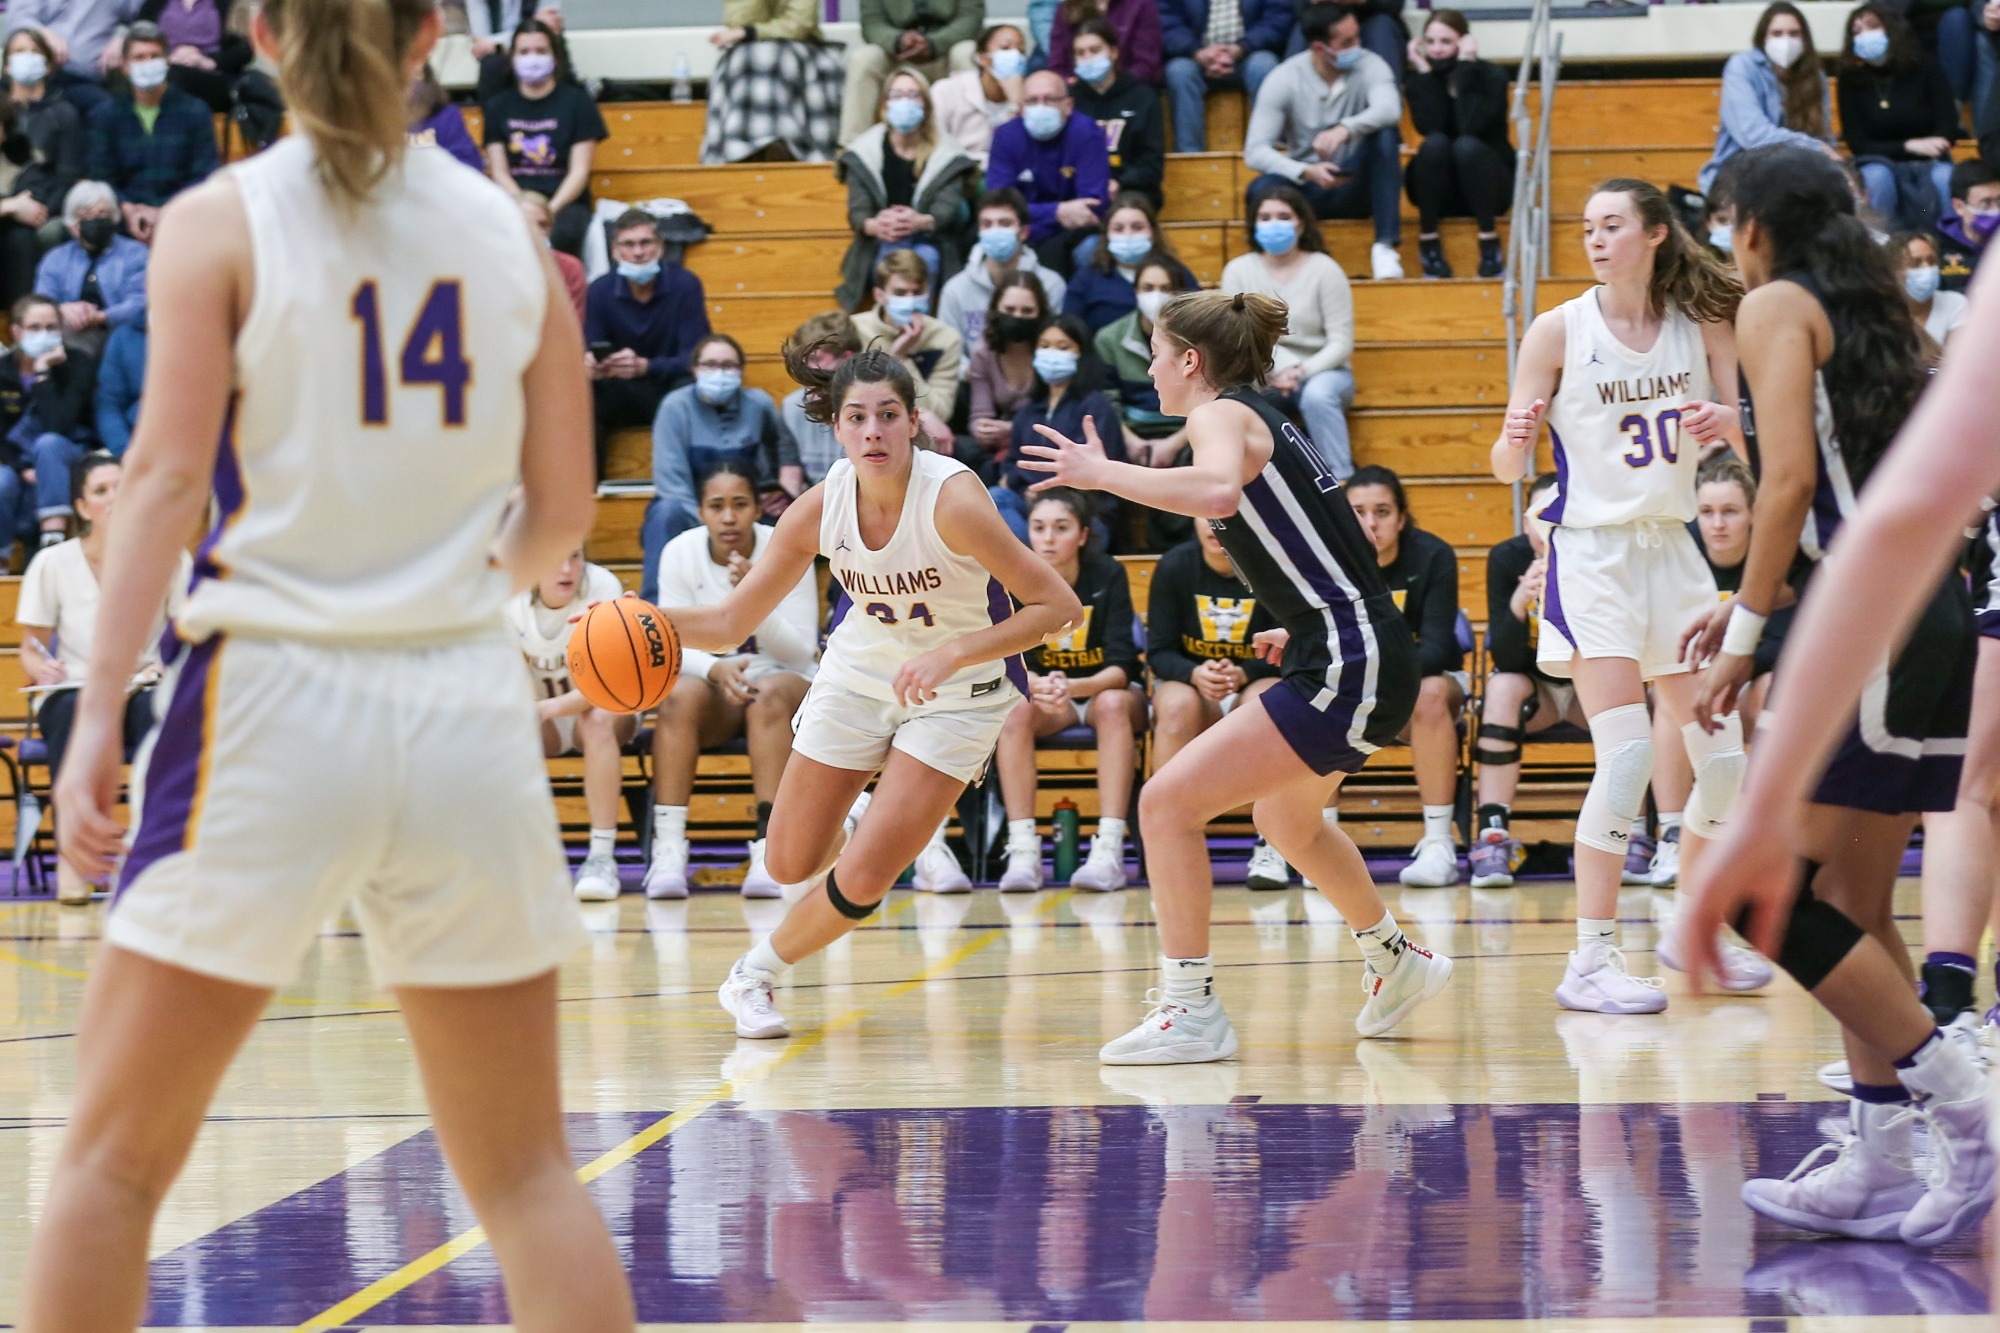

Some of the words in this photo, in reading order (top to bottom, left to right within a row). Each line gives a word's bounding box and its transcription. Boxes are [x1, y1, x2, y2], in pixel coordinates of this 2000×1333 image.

[349, 278, 474, 430] 14
[1619, 408, 1682, 469] 30
[840, 566, 942, 595] WILLIAMS
[636, 613, 666, 668] NCAA
[541, 676, 571, 699] 11
